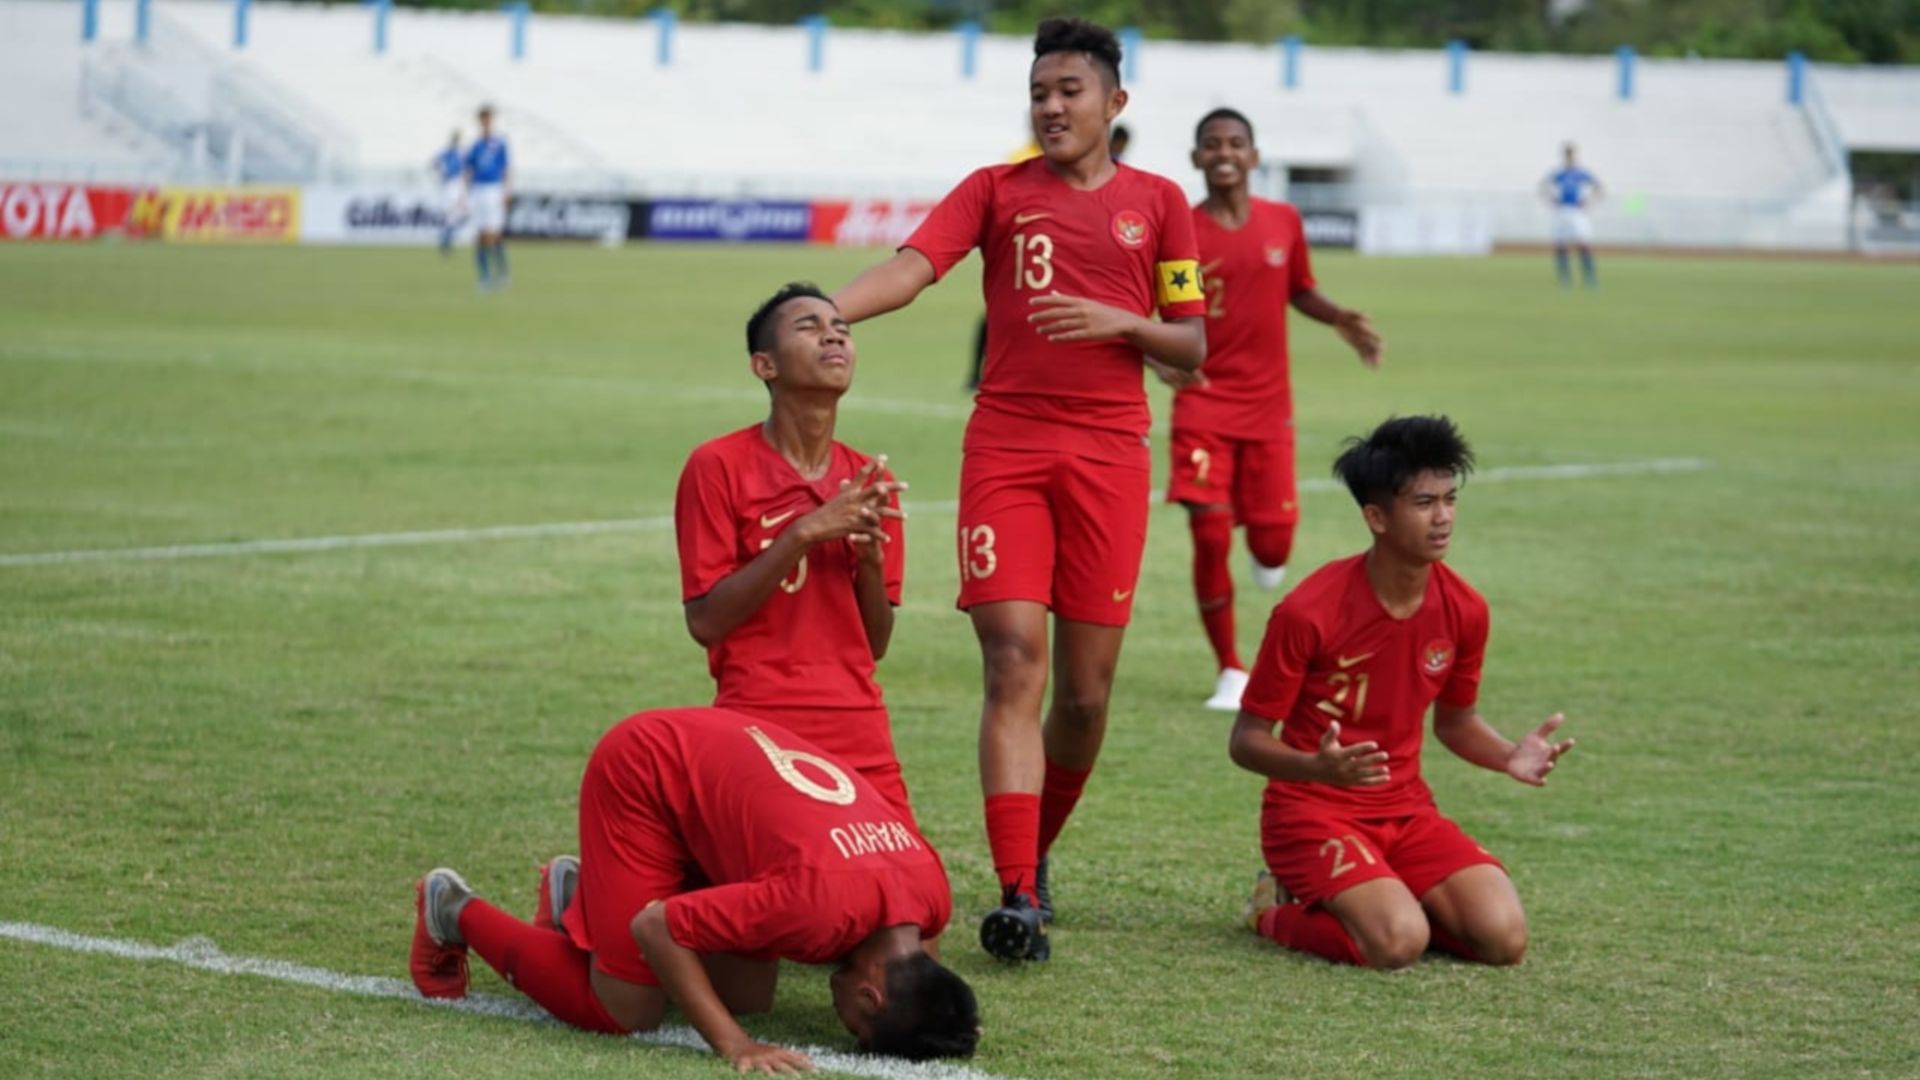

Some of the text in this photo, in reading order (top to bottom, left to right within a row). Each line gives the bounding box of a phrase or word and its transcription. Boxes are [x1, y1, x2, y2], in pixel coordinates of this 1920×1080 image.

[1012, 233, 1054, 290] 13
[959, 523, 997, 582] 13
[1316, 672, 1370, 723] 21
[829, 820, 922, 860] WAHYU
[1319, 834, 1377, 880] 21
